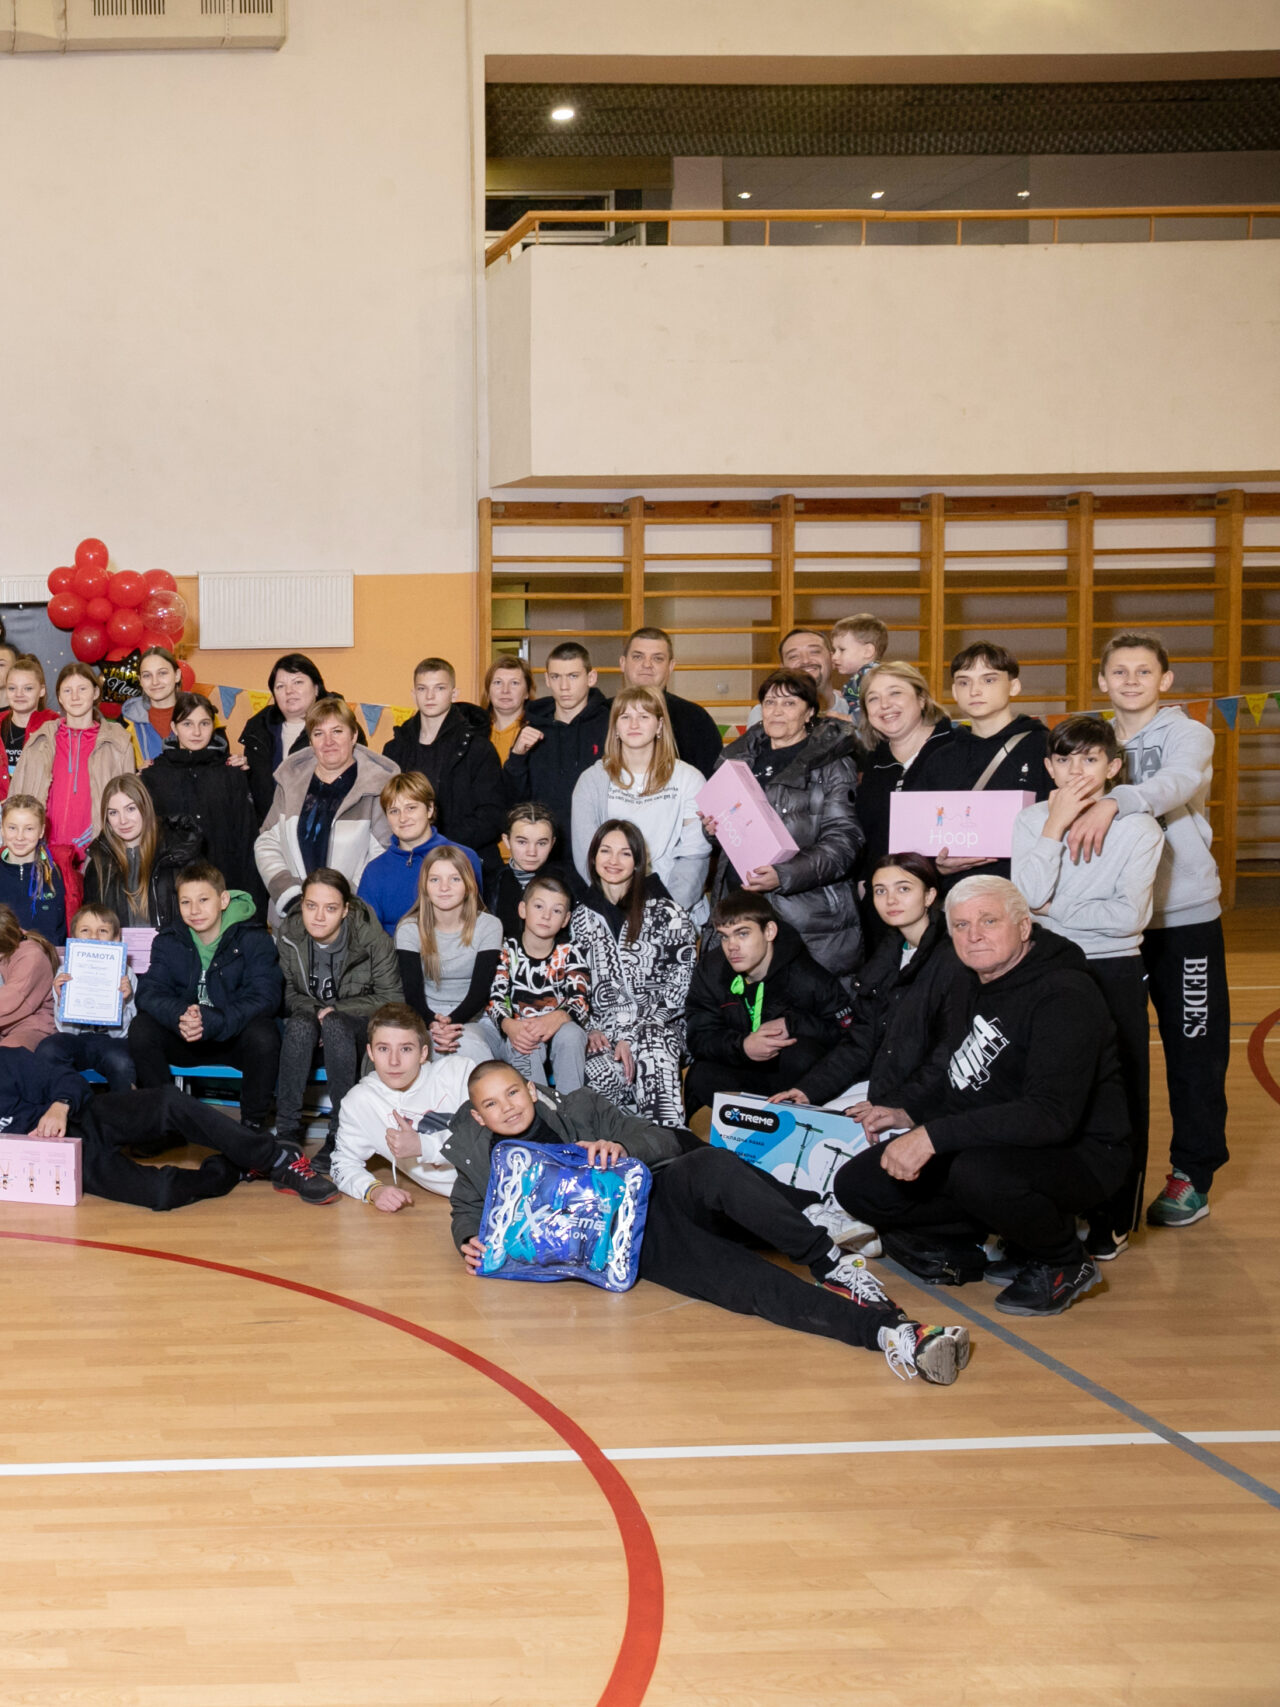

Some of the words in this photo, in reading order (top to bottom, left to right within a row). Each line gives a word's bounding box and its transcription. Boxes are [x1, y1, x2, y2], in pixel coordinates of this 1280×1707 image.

[107, 677, 140, 697] New
[717, 811, 742, 848] Hoop
[929, 828, 979, 848] Hoop
[77, 951, 115, 960] ГРАМОТА
[1183, 955, 1208, 1038] BEDE'S
